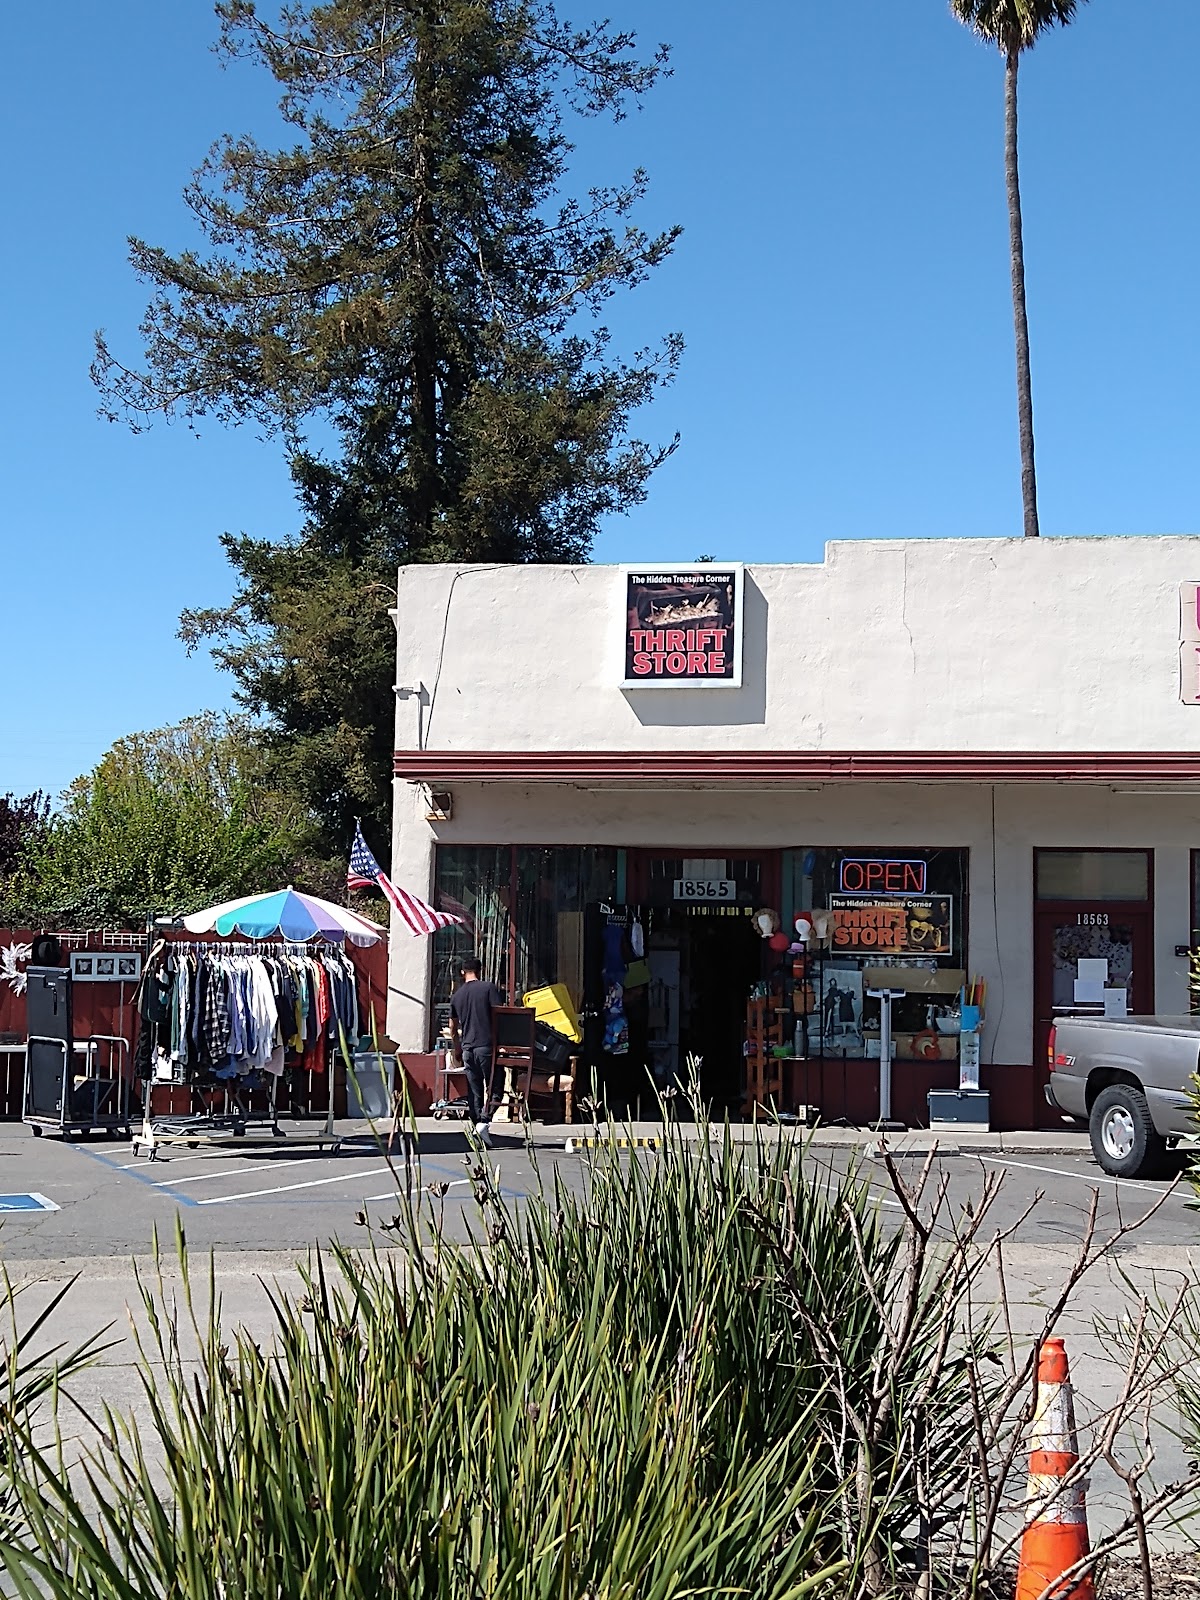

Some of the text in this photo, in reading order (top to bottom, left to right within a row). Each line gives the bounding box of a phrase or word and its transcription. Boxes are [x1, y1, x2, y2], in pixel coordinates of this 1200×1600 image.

[632, 574, 730, 584] The Hidden Treasure Corner
[630, 629, 727, 652] THRIFT
[633, 652, 725, 674] STORE
[844, 863, 923, 890] OPEN
[679, 881, 729, 897] 18565
[874, 900, 906, 908] Treasure
[833, 909, 908, 927] THRIFT
[1077, 913, 1109, 925] 18563
[834, 927, 908, 946] STORE
